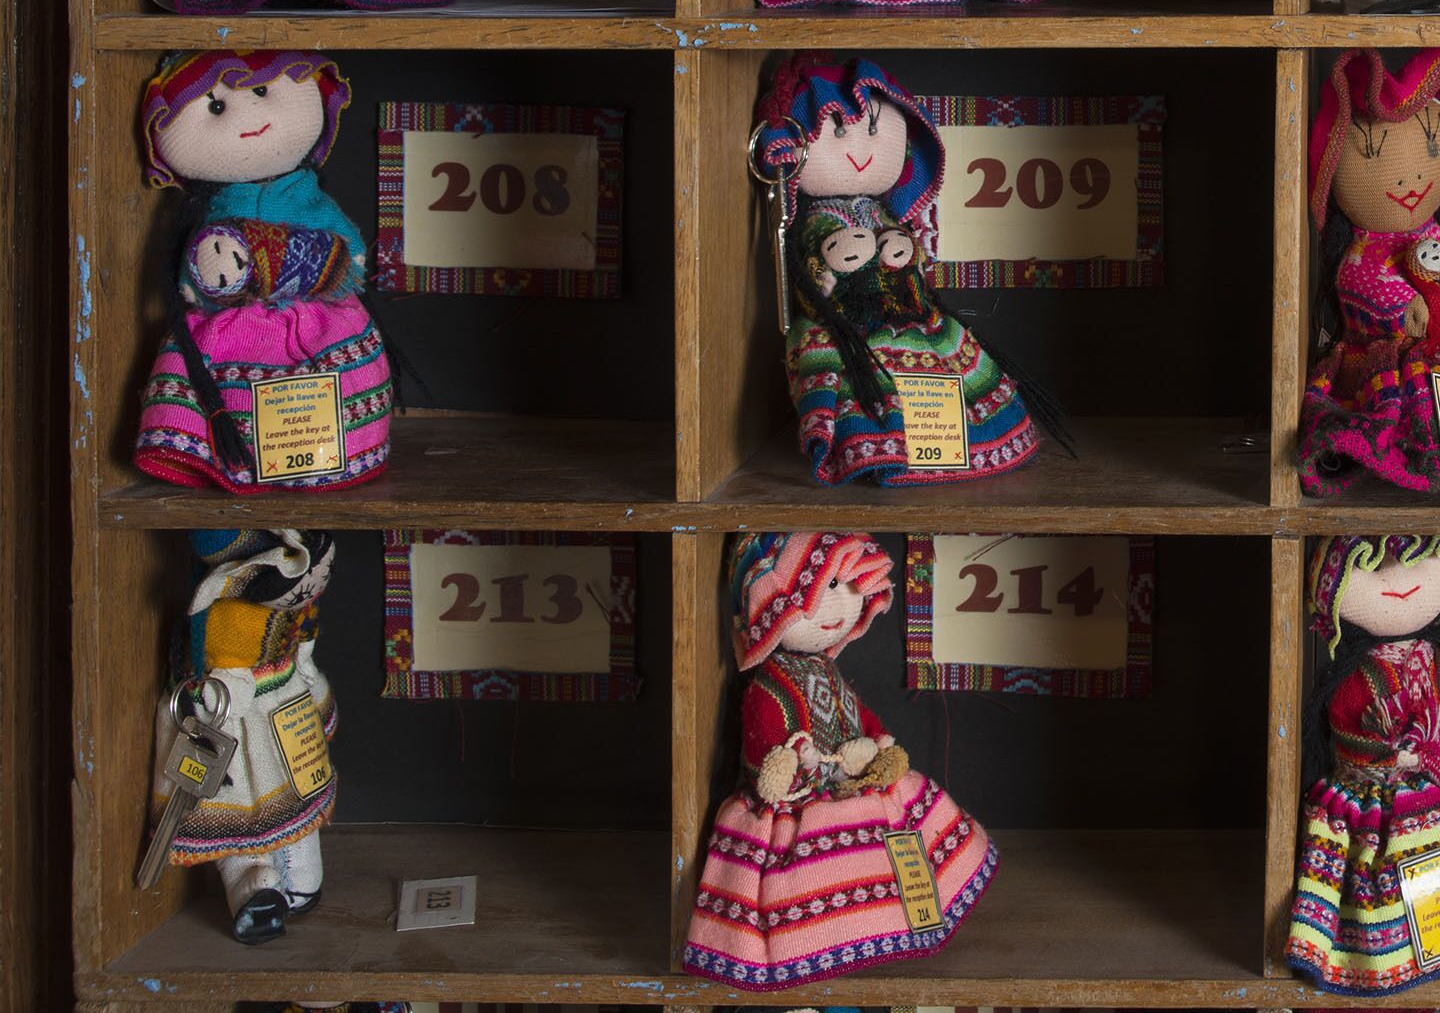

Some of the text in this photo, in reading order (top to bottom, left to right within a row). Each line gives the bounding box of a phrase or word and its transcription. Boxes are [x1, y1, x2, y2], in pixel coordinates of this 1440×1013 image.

[428, 162, 571, 216] 208
[964, 157, 1111, 210] 209
[265, 397, 285, 406] Dejar
[277, 404, 316, 415] recepción
[283, 415, 312, 425] PLEASE
[266, 431, 289, 439] Leave
[290, 428, 303, 436] the
[306, 426, 320, 434] key
[909, 433, 943, 441] reception
[278, 439, 315, 449] reception
[317, 435, 335, 443] desk
[286, 453, 314, 468] 208
[916, 447, 942, 460] 209
[956, 564, 1103, 616] 214
[439, 573, 583, 624] 213
[292, 752, 307, 763] Leave
[308, 746, 316, 754] the
[187, 764, 204, 778] 106
[293, 765, 302, 774] the
[918, 908, 930, 922] 214
[1422, 925, 1433, 934] the
